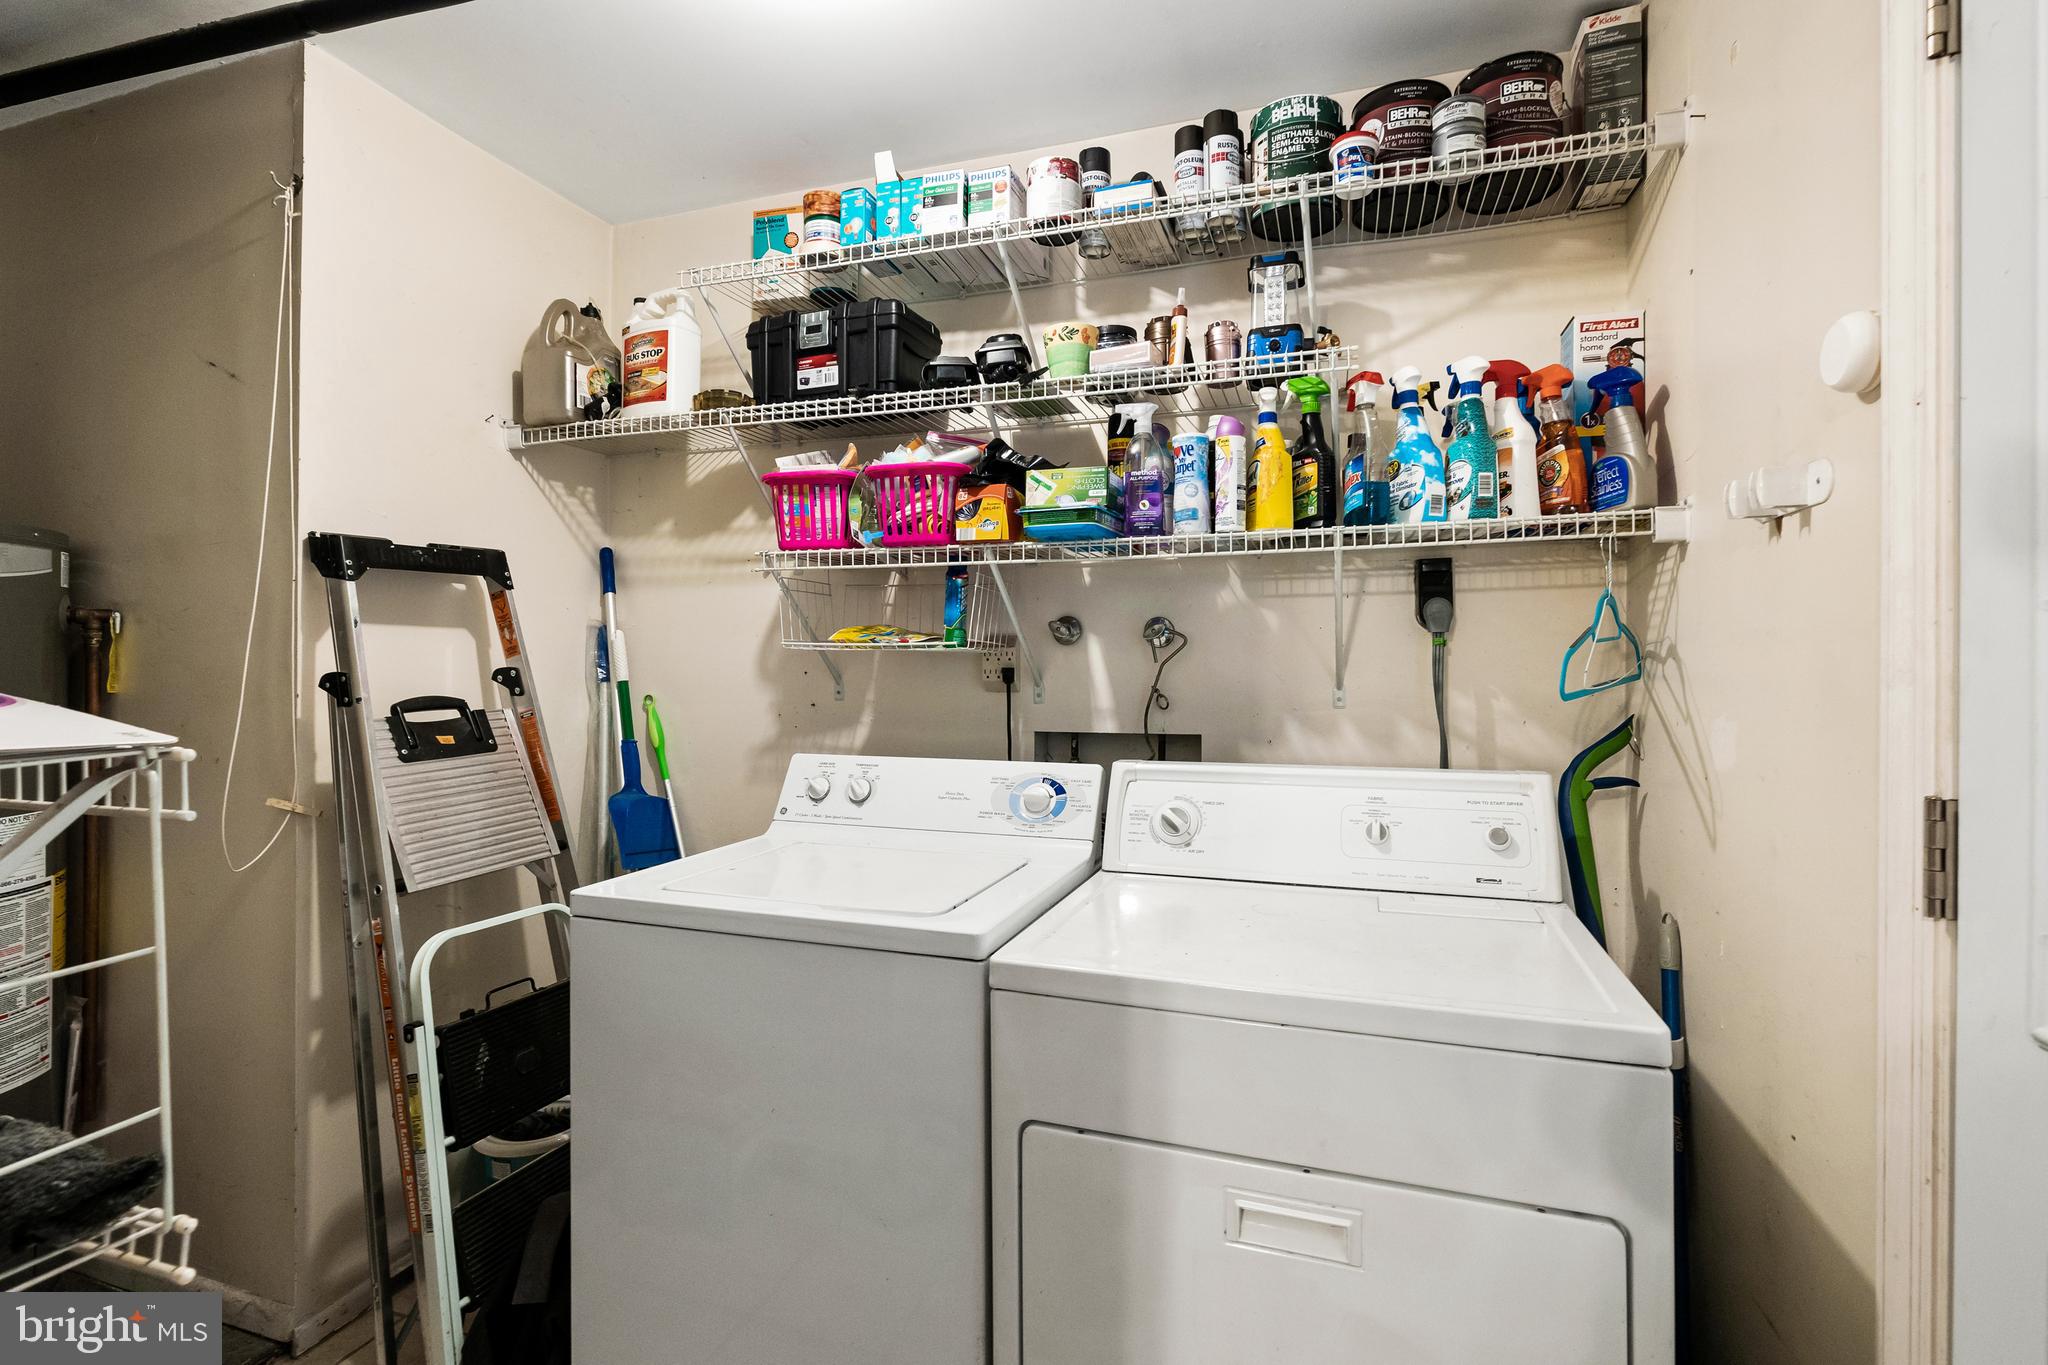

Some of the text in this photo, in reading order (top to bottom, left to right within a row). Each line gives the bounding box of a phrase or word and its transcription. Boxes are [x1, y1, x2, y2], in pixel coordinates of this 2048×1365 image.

[1600, 15, 1622, 25] Kidde
[1506, 59, 1531, 67] EXTERIOR
[1503, 80, 1534, 96] BEHR
[1503, 93, 1544, 102] ULTRA
[1271, 103, 1307, 124] BEHR
[1390, 107, 1418, 121] BEHR
[1497, 105, 1551, 117] STAIN-BLOCKING
[1390, 120, 1429, 128] ULTRA
[1271, 129, 1336, 143] URETHANE ALKYD
[1384, 131, 1432, 142] STAIN-BLOCKIN
[1398, 138, 1423, 146] PRIMER
[1271, 136, 1319, 151] SEMI-GLOSS
[1271, 144, 1306, 158] ENAMEL
[925, 172, 961, 184] PHILIPS
[971, 169, 1007, 182] PHILIPS
[1582, 319, 1636, 332] First Alert
[1579, 332, 1619, 343] standard
[1579, 344, 1604, 352] home
[626, 348, 663, 363] BUG STOP
[1585, 414, 1596, 426] 1x
[1594, 466, 1619, 486] Perfect
[1592, 478, 1622, 498] Stainless
[8, 816, 22, 824] NOT
[391, 1057, 417, 1228] Little Giant Ladder Systems
